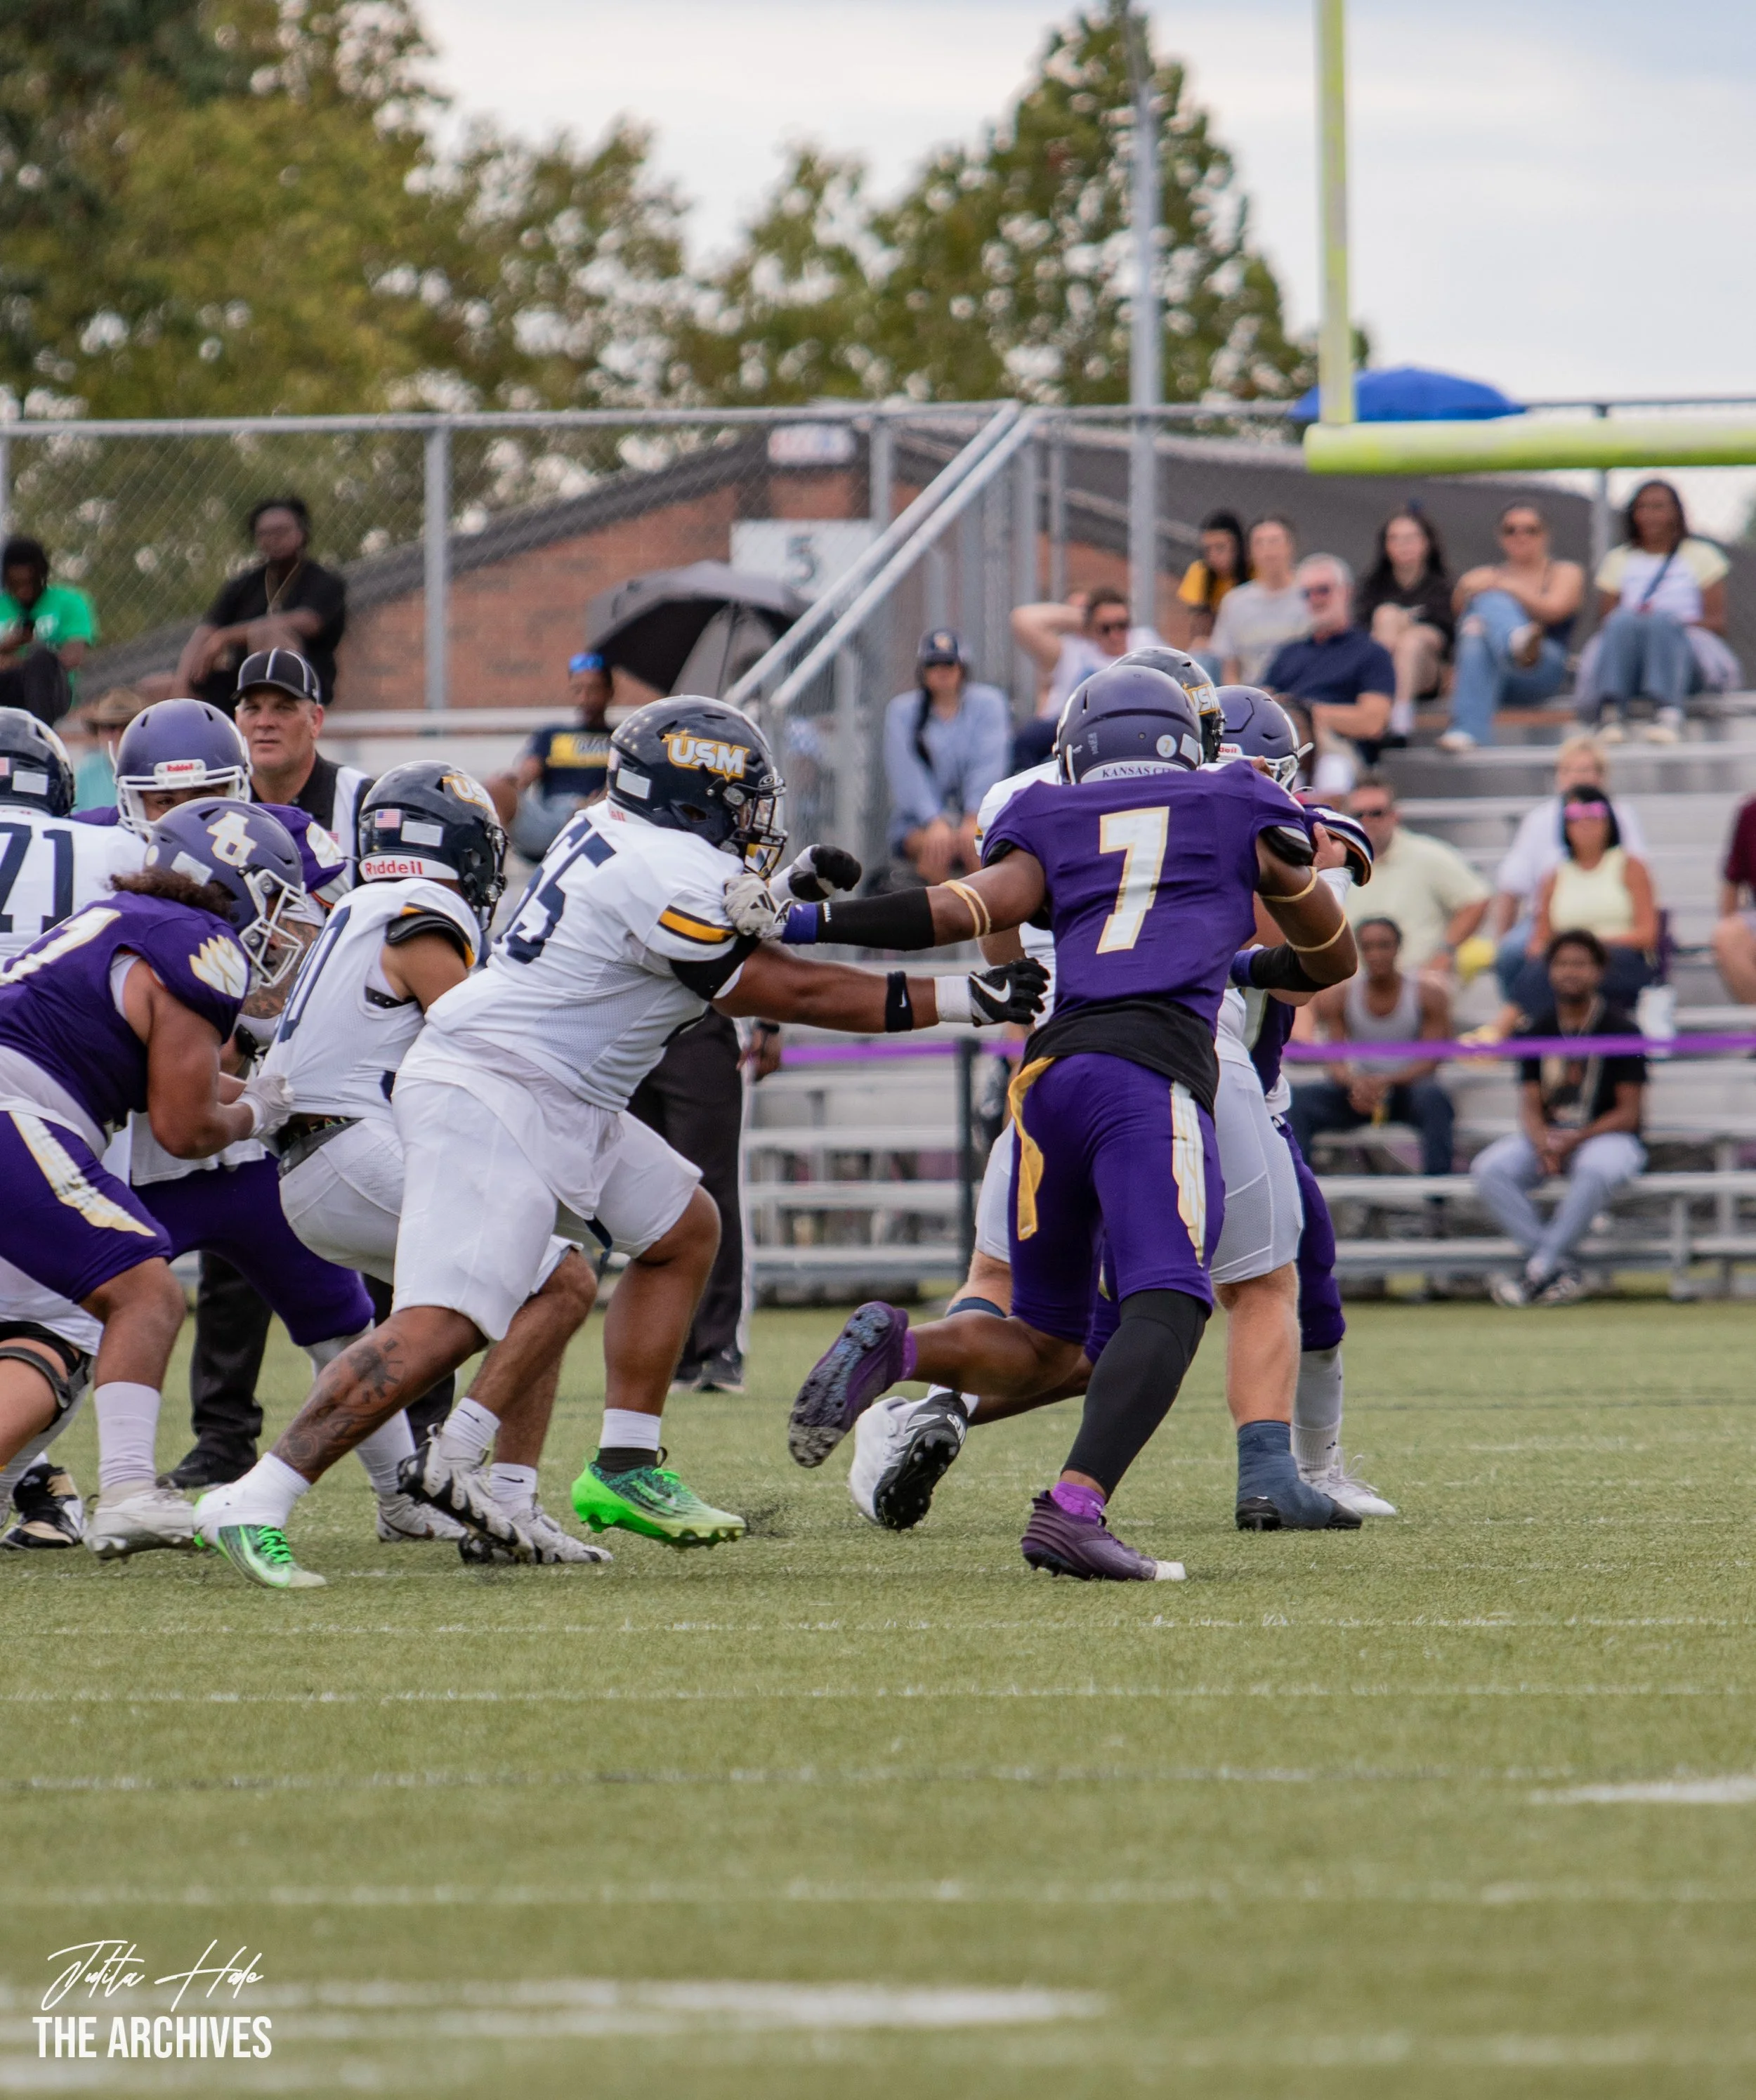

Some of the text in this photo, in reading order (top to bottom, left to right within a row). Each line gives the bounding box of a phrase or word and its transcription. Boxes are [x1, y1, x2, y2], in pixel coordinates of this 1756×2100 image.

[665, 733, 749, 780] USM
[1102, 764, 1151, 778] KANSAS
[450, 776, 494, 809] US
[0, 822, 74, 935] 71
[365, 859, 424, 875] Riddell
[1096, 806, 1169, 954] 7
